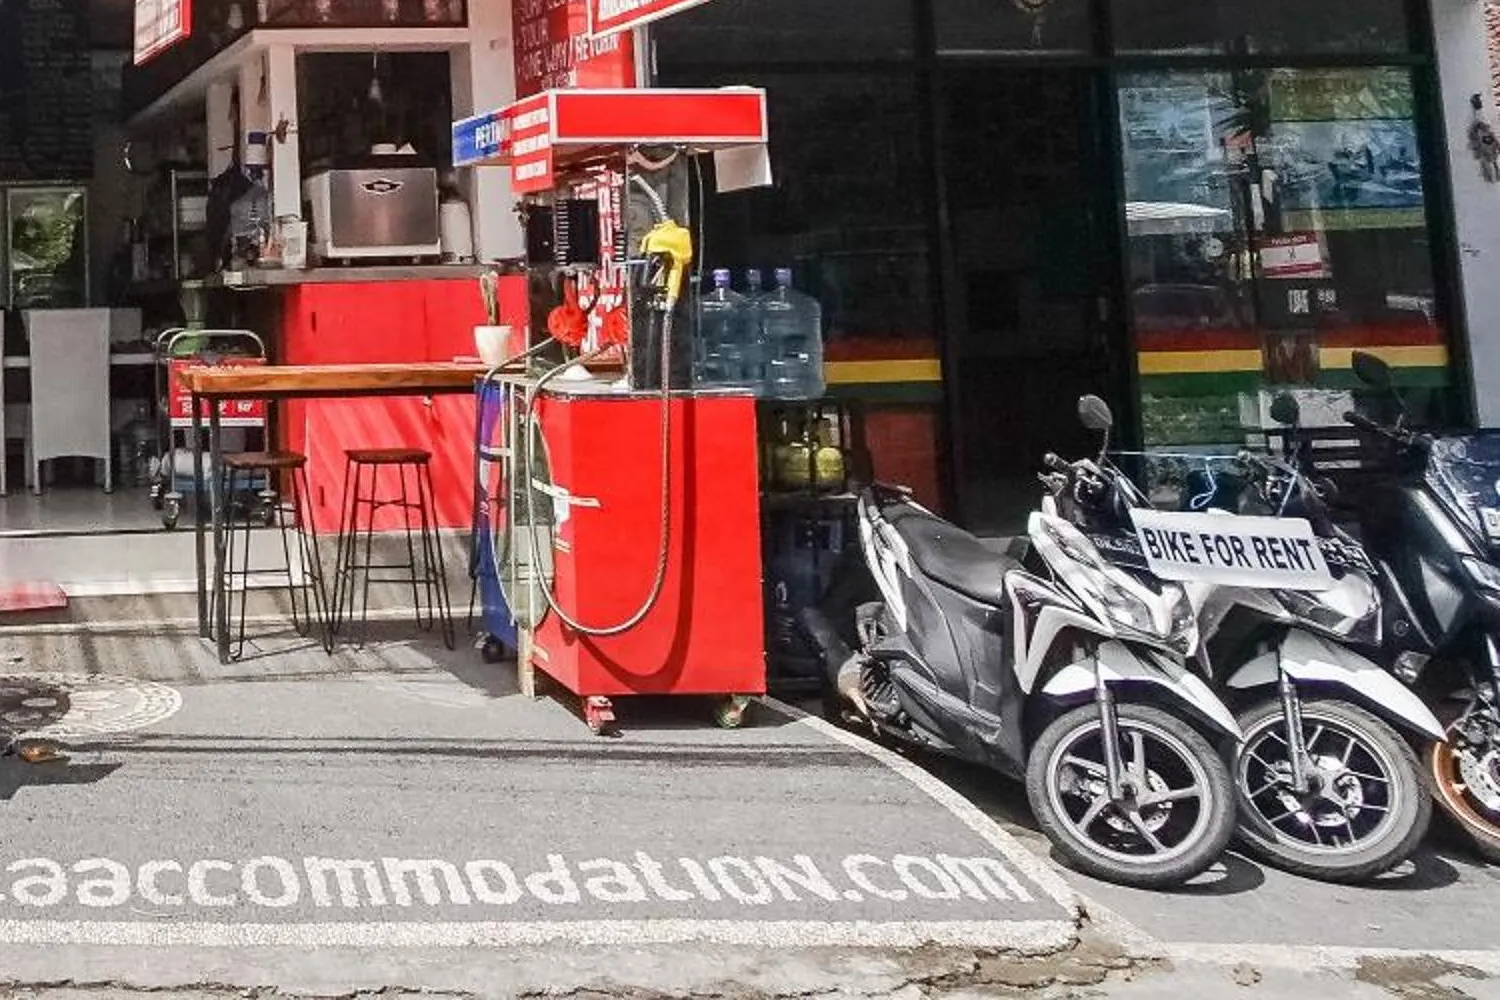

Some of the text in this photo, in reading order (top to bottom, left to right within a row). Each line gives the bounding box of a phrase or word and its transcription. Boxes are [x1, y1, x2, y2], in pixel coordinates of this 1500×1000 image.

[1141, 527, 1201, 566] BIKE
[1200, 533, 1253, 569] FOR
[1250, 535, 1318, 571] RENT
